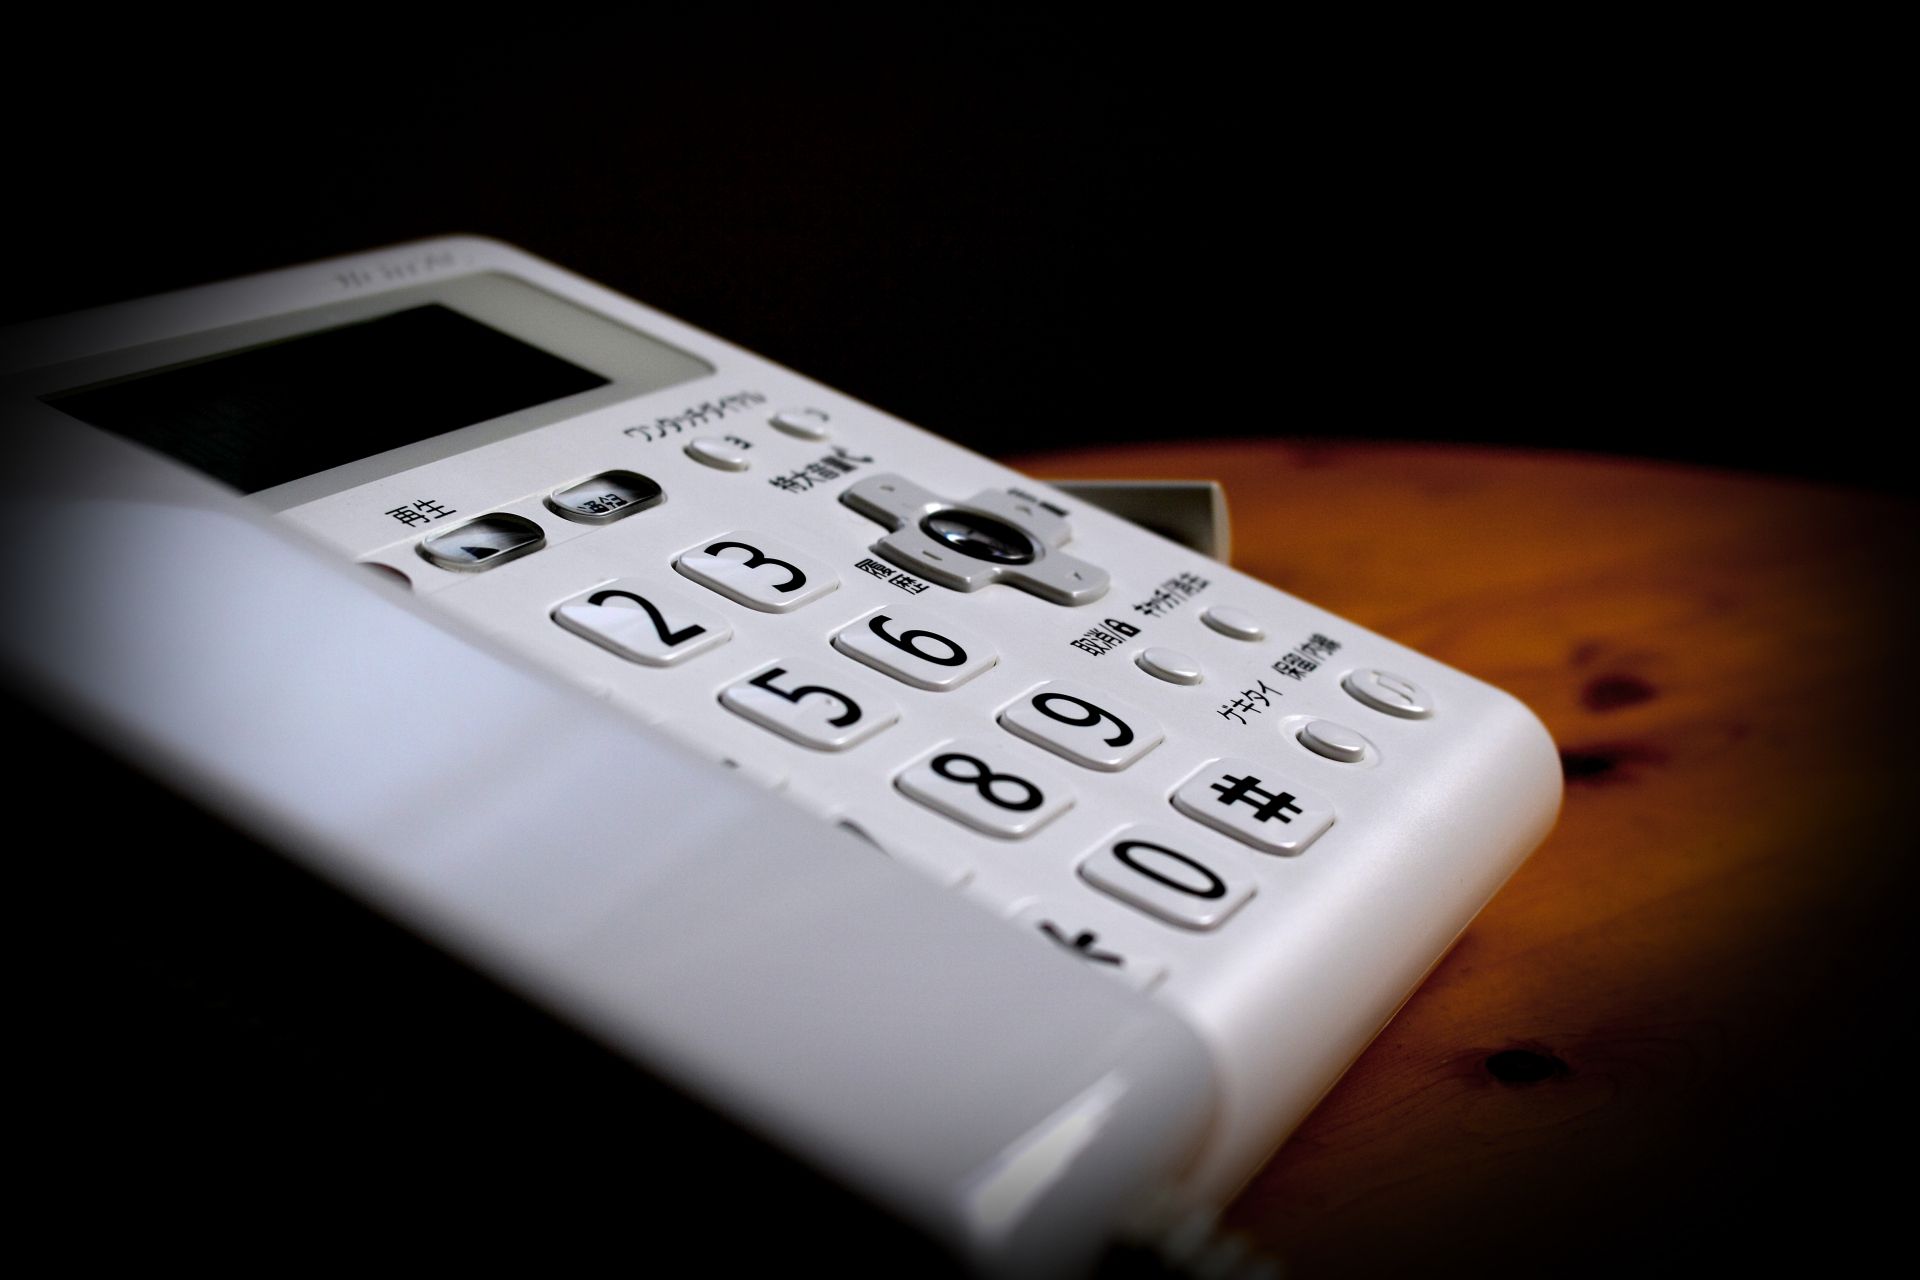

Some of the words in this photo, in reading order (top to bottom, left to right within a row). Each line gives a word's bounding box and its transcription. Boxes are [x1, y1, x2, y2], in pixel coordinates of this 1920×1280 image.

[385, 499, 457, 528] 再生
[704, 542, 806, 593] 3
[855, 557, 931, 596] 履歴
[588, 589, 706, 647] 2
[868, 615, 968, 667] 6
[750, 667, 863, 728] 5
[1031, 693, 1134, 747] 9
[1217, 679, 1283, 726] ゲキタイ
[930, 752, 1044, 811] 8
[1211, 774, 1302, 825] #
[1113, 839, 1227, 899] 0
